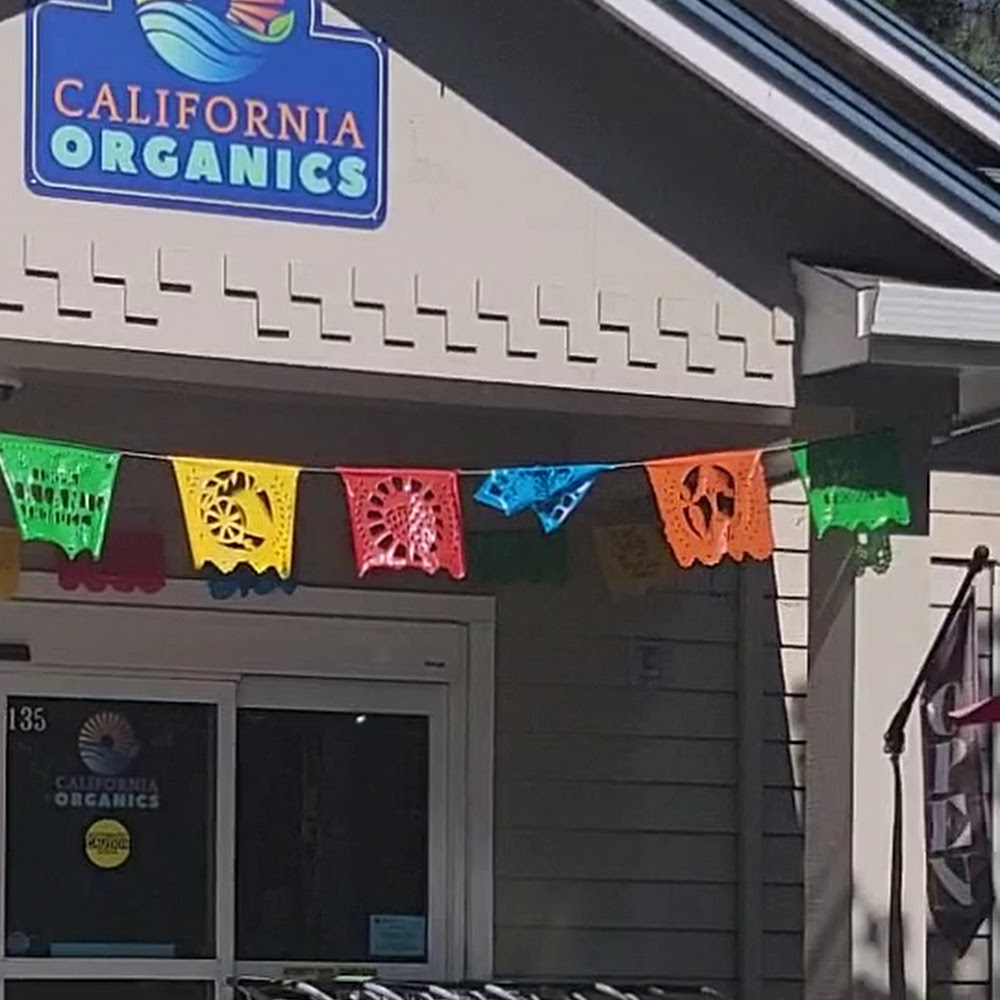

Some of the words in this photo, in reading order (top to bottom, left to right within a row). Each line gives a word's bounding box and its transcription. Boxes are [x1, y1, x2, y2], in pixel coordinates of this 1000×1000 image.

[53, 78, 366, 149] CALIFORNIA
[50, 125, 368, 198] ORGANICS
[9, 706, 47, 731] 135
[55, 776, 159, 792] CALIFORNIA
[55, 792, 160, 808] ORGANICS
